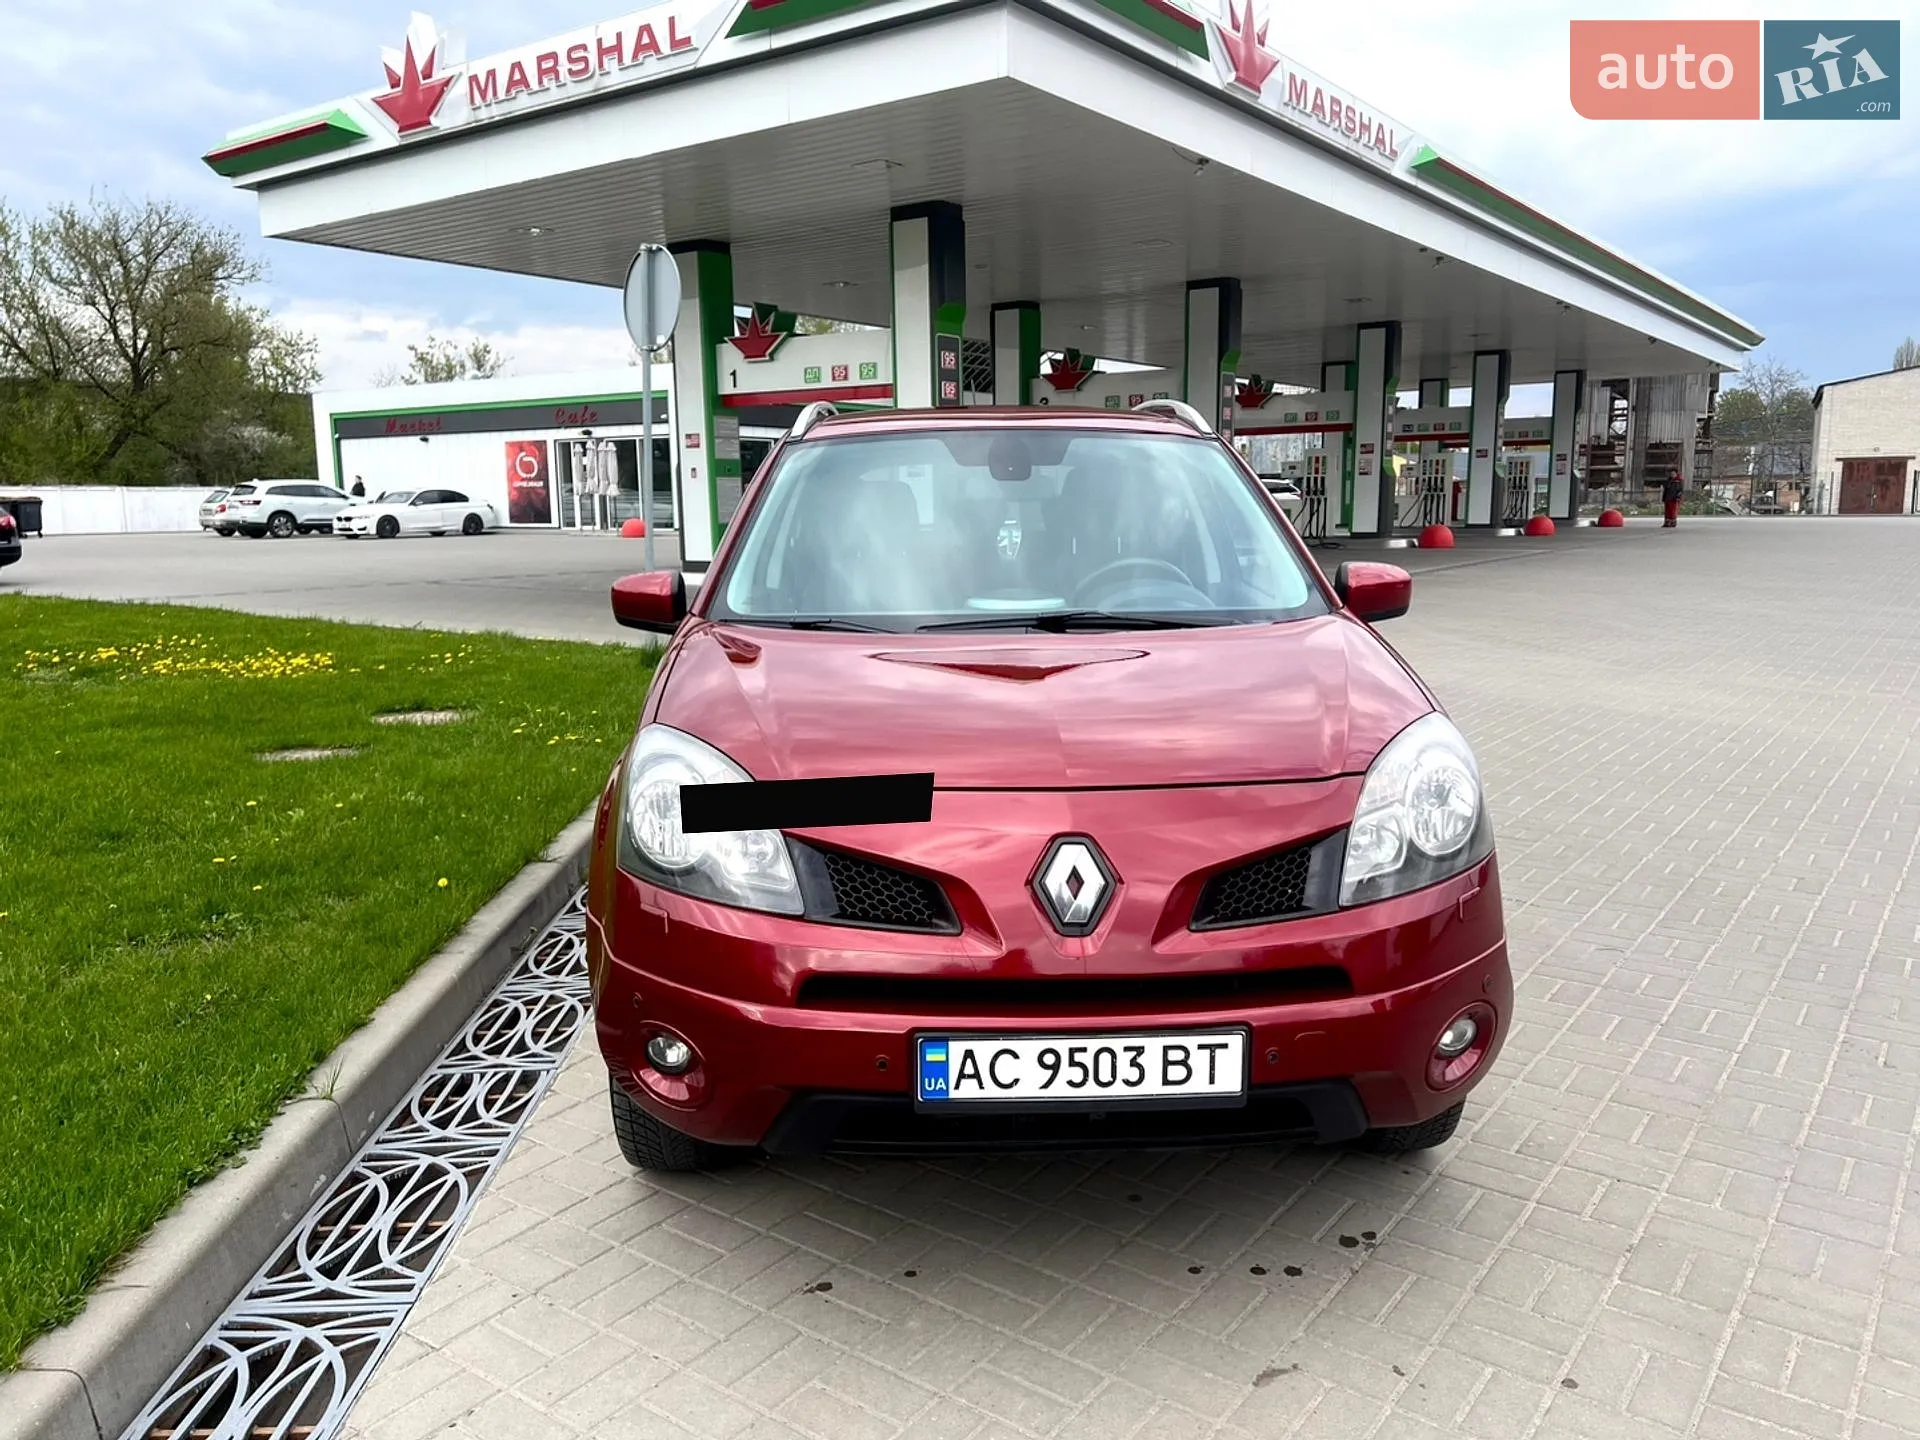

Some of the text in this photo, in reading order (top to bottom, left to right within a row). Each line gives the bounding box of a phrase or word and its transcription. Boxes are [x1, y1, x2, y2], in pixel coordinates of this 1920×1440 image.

[468, 15, 694, 108] MARSHAL
[1286, 72, 1399, 159] MARSHAL
[729, 369, 738, 388] 1
[555, 404, 598, 425] Cafe
[953, 1042, 1229, 1091] AC 9503 BT
[925, 1077, 947, 1092] UA
